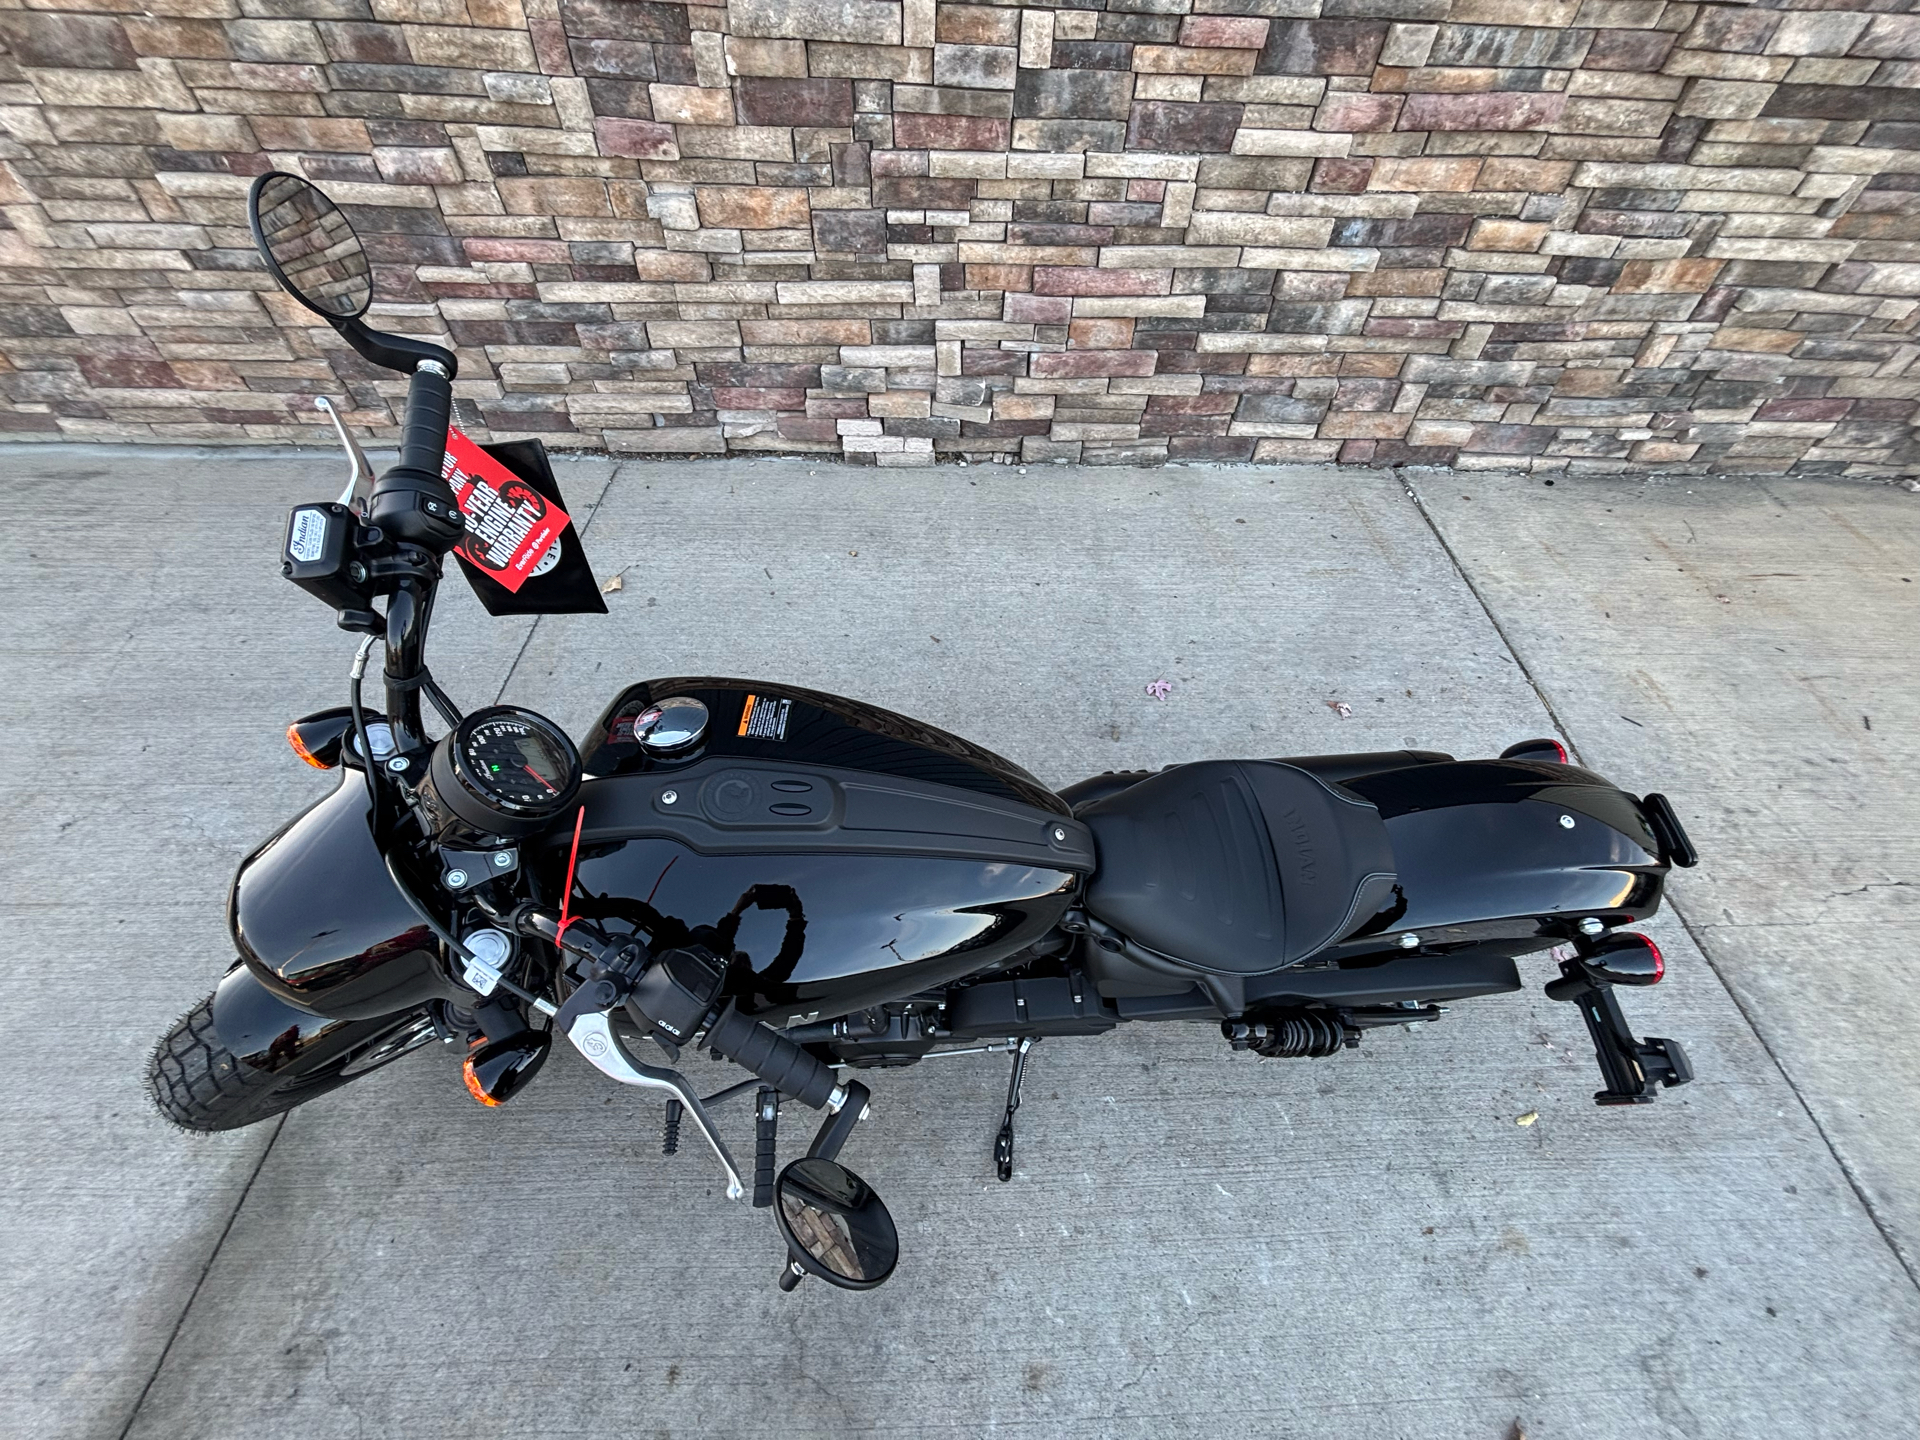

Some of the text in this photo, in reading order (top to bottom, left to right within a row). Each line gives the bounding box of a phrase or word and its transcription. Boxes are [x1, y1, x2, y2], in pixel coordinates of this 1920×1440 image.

[293, 515, 309, 555] Indian
[474, 496, 516, 545] ENGINE
[485, 499, 541, 568] WARRANTY
[515, 547, 534, 571] EverRide
[476, 734, 487, 745] 100
[491, 764, 500, 772] N
